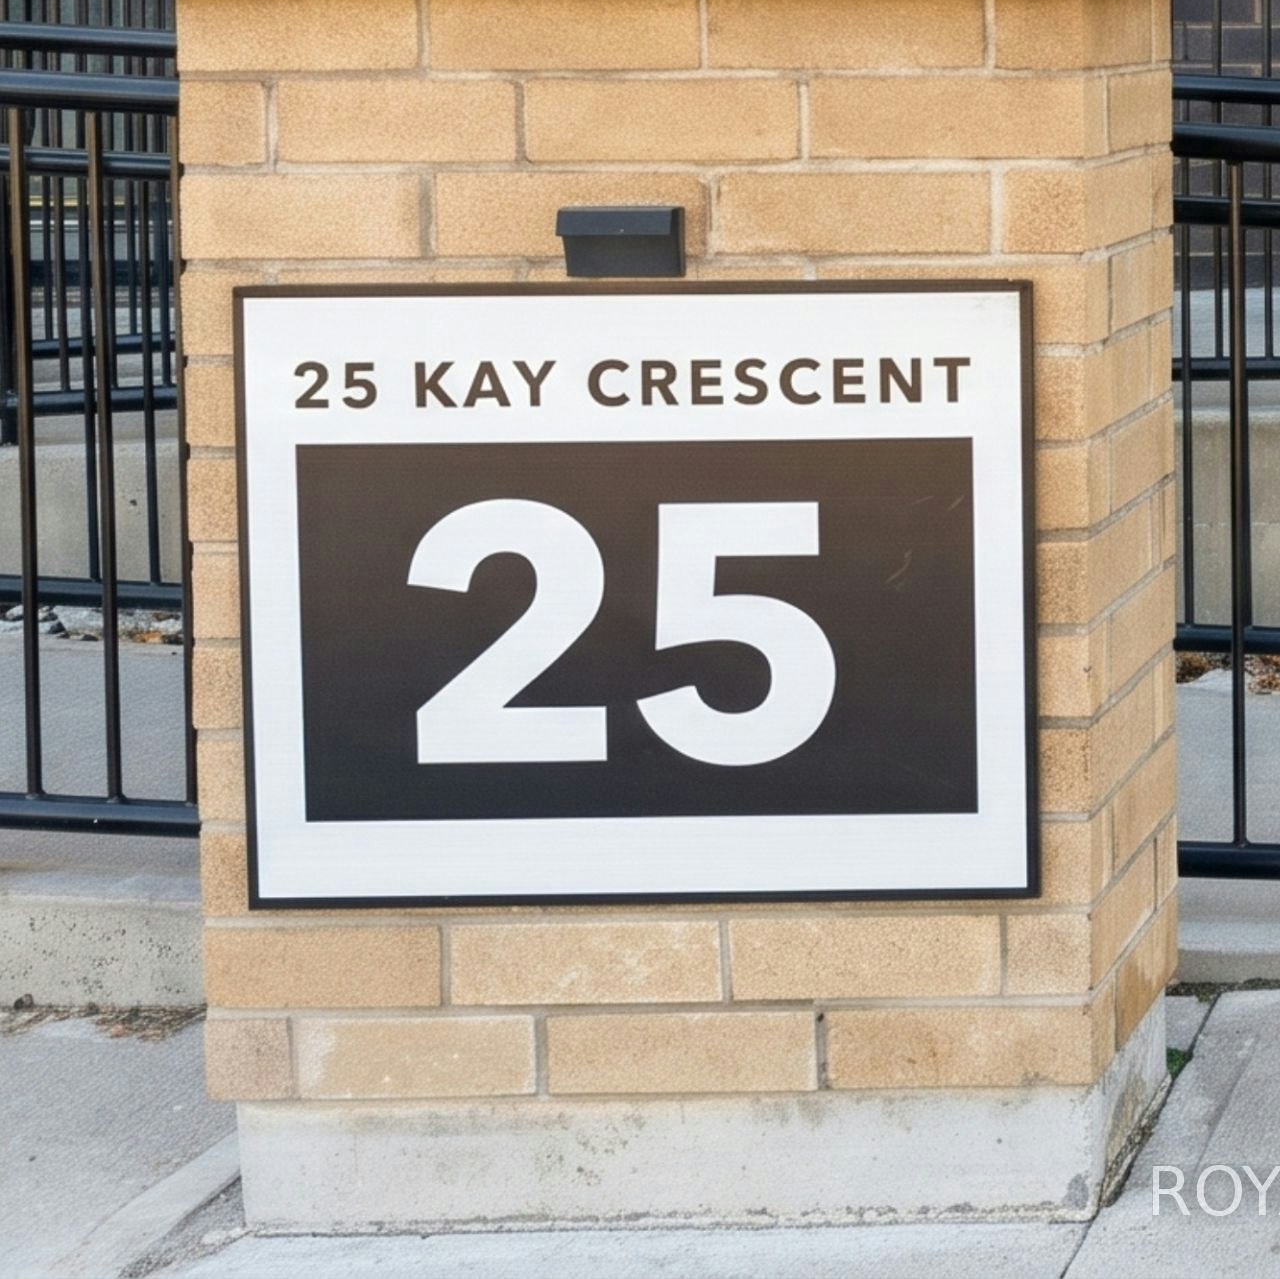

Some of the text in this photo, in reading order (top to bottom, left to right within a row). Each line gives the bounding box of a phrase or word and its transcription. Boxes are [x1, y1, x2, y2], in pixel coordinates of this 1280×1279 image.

[293, 356, 971, 409] 25 KAY CRESCENT
[406, 498, 836, 767] 25
